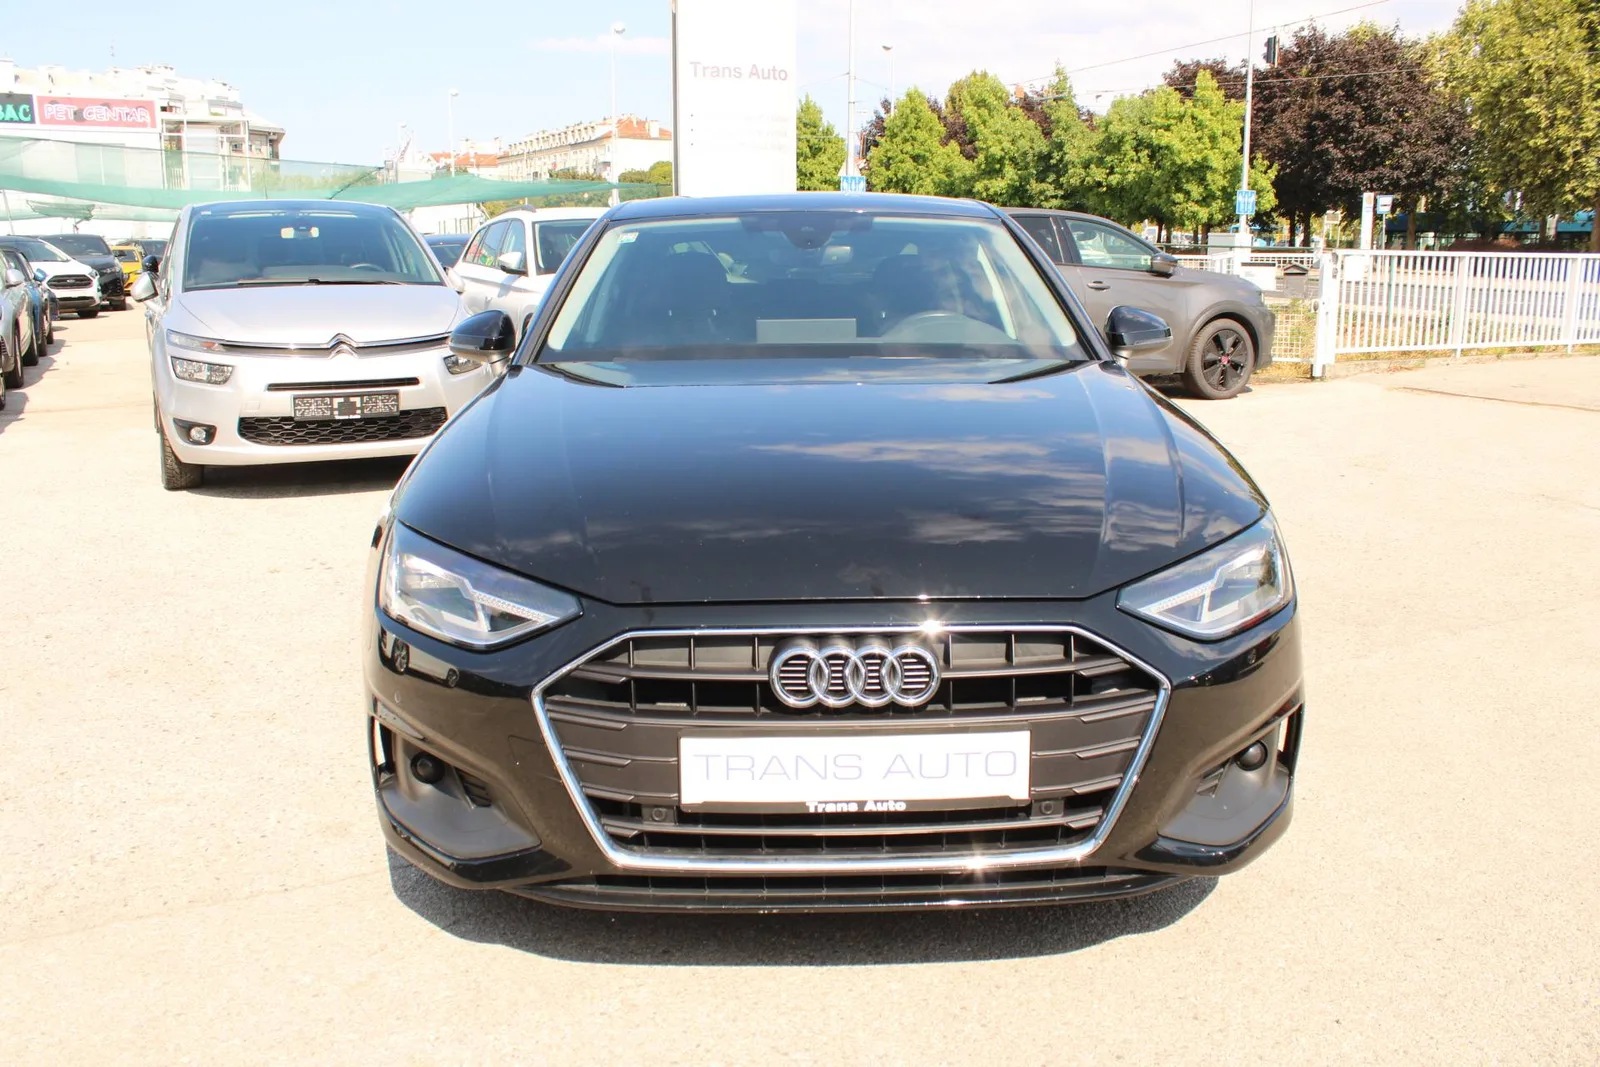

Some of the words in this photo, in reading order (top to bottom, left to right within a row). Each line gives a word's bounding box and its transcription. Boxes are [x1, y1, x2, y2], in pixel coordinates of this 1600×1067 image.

[689, 61, 743, 79] Trans
[748, 64, 789, 81] Auto
[44, 103, 77, 121] PET
[83, 105, 150, 126] CENTAR
[693, 754, 863, 781] TRANS
[881, 750, 1018, 780] AUTO
[805, 801, 859, 813] Trans
[863, 800, 907, 812] Auto
